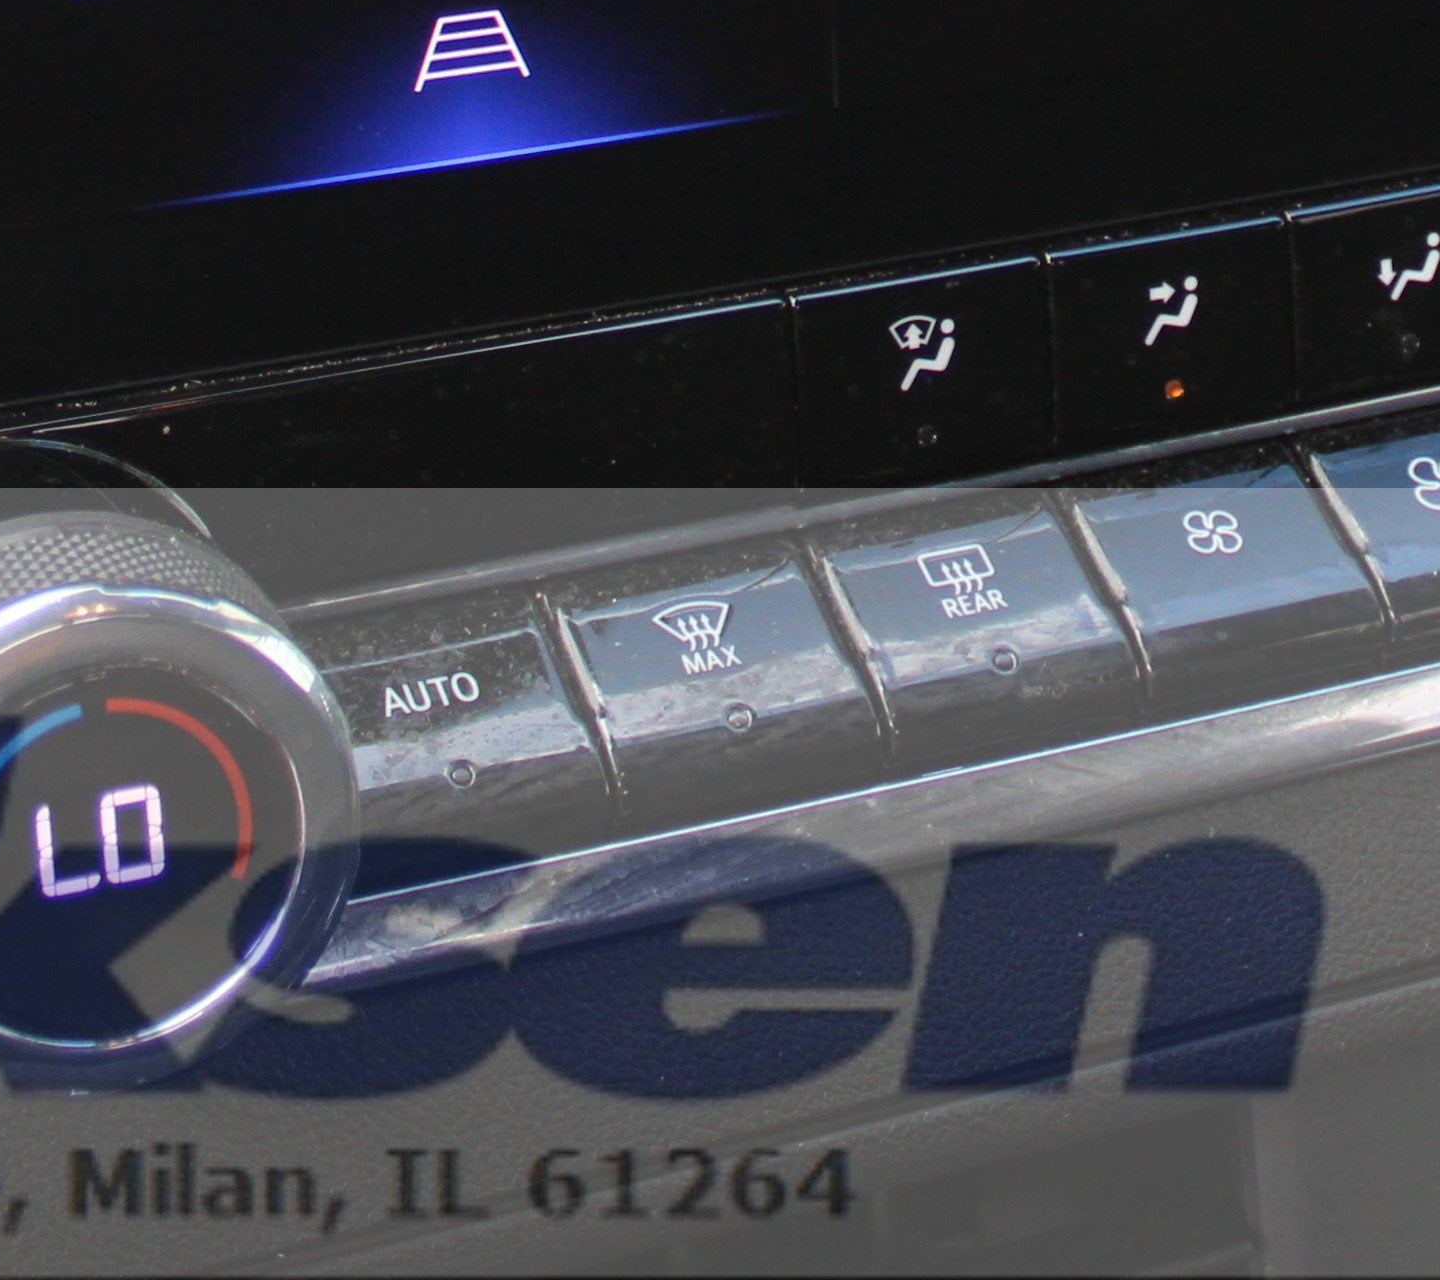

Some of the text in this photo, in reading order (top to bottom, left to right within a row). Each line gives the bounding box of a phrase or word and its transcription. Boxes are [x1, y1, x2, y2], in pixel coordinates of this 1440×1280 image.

[941, 589, 1009, 620] REAR
[681, 643, 743, 677] MAX
[382, 671, 481, 719] AUTO
[34, 782, 166, 899] LO
